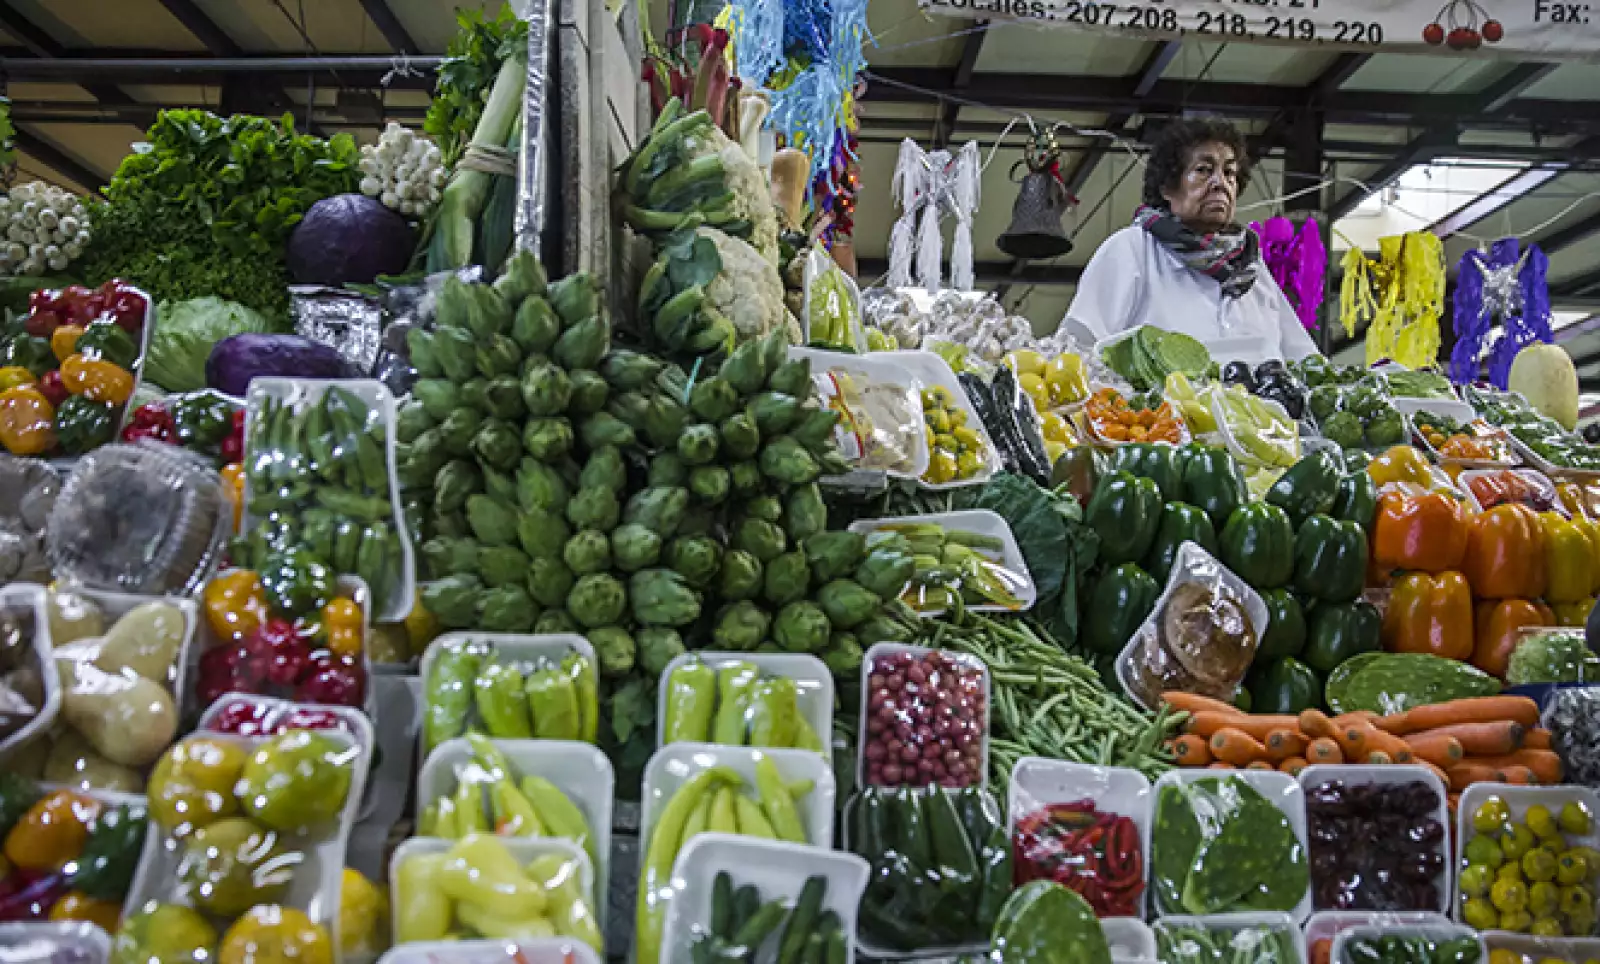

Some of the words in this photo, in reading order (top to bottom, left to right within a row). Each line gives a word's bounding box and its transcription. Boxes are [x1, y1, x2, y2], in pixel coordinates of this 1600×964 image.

[931, 0, 1056, 20] ocales:
[1196, 11, 1255, 41] 218,
[1265, 16, 1324, 45] 219,
[1333, 20, 1384, 45] 220
[1534, 0, 1589, 24] Fax:
